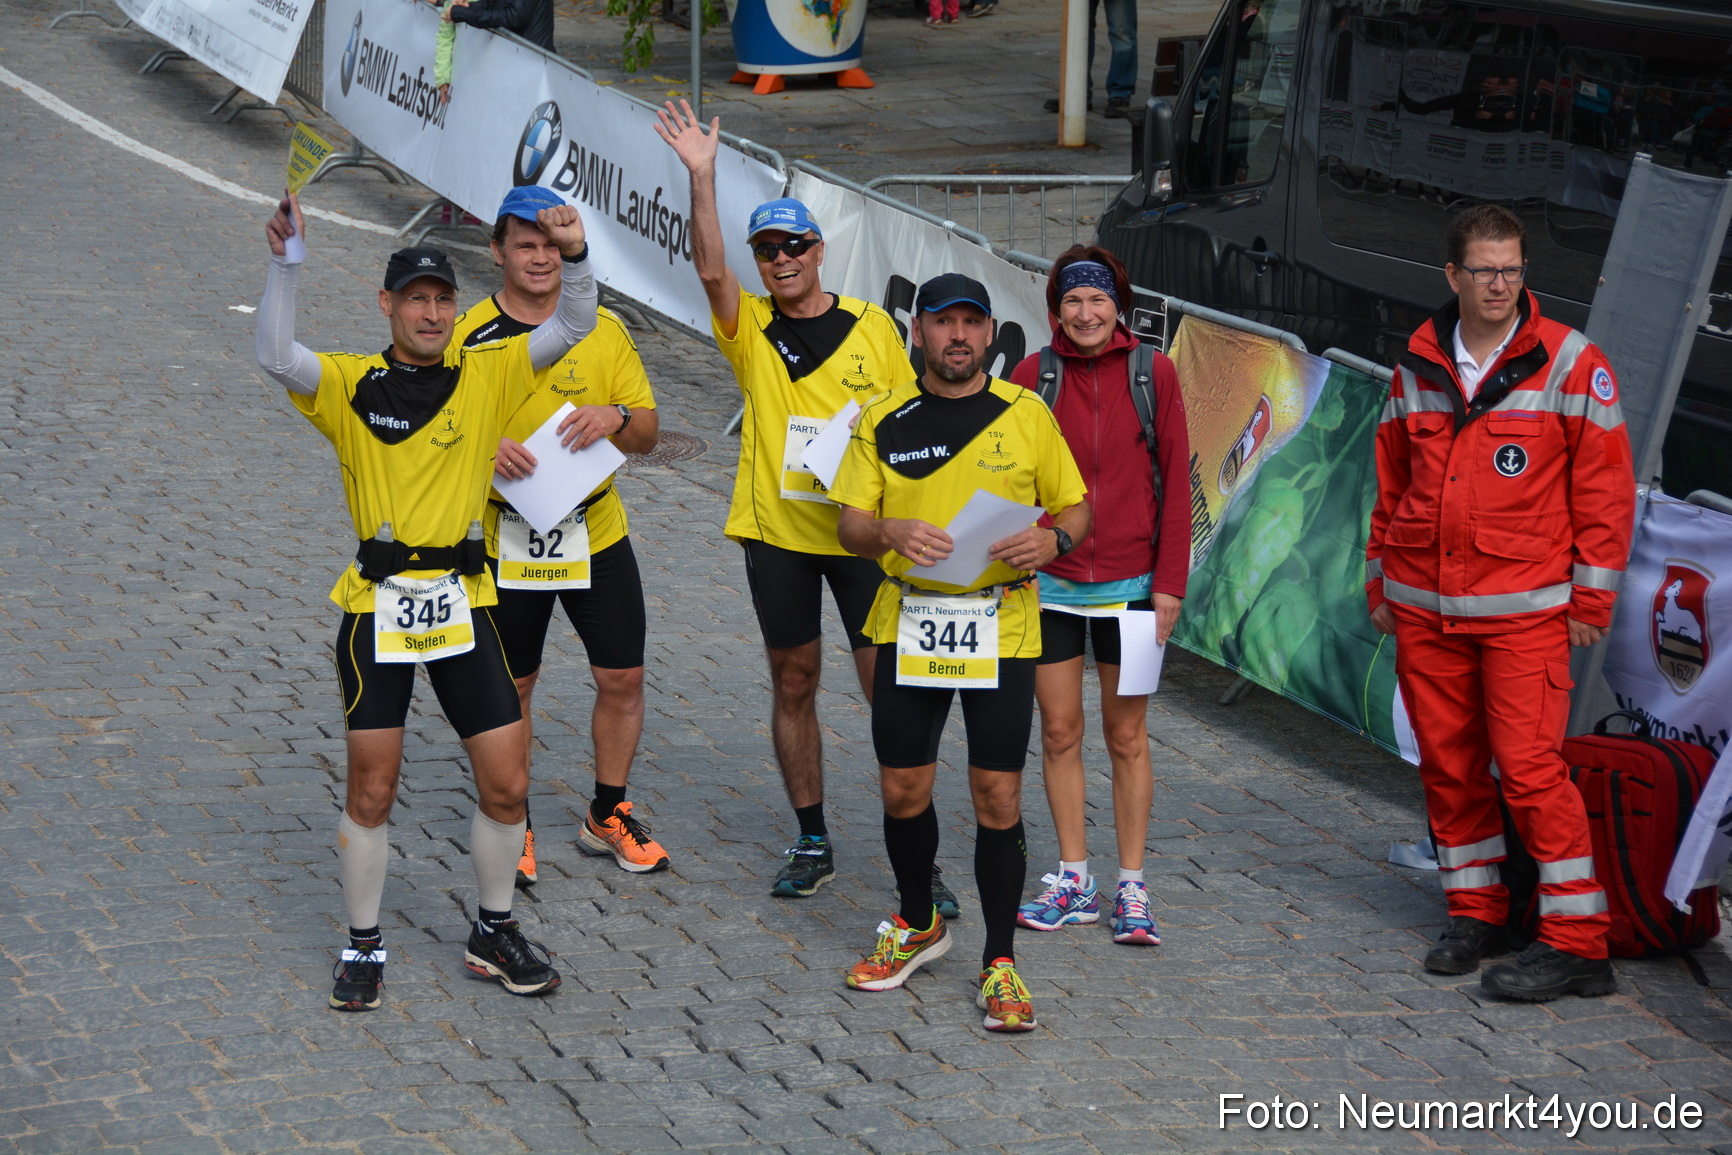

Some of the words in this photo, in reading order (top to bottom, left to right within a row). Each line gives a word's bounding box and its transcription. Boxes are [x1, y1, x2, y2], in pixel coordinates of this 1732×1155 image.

[356, 37, 394, 97] BMW
[551, 138, 615, 217] BMW
[616, 166, 693, 267] Laufspo
[562, 358, 579, 366] TSV
[550, 384, 589, 397] Burgthann
[841, 377, 875, 392] Burgthann
[442, 408, 456, 416] TSV
[789, 423, 820, 435] PARTL
[987, 431, 1005, 439] TSV
[889, 447, 929, 464] Bernd
[931, 445, 951, 458] W.
[977, 459, 1018, 473] Burgthann
[502, 514, 529, 524] PART
[528, 528, 564, 559] 52
[520, 565, 568, 581] Juergen
[379, 581, 409, 594] PARTL
[410, 579, 448, 596] Neumarkt
[396, 592, 452, 629] 345
[901, 605, 933, 615] PARTL
[935, 606, 981, 616] Neumarkt
[404, 634, 446, 650] Steffen
[918, 619, 979, 653] 344
[928, 661, 966, 675] Bernd
[1669, 660, 1697, 684] 1628
